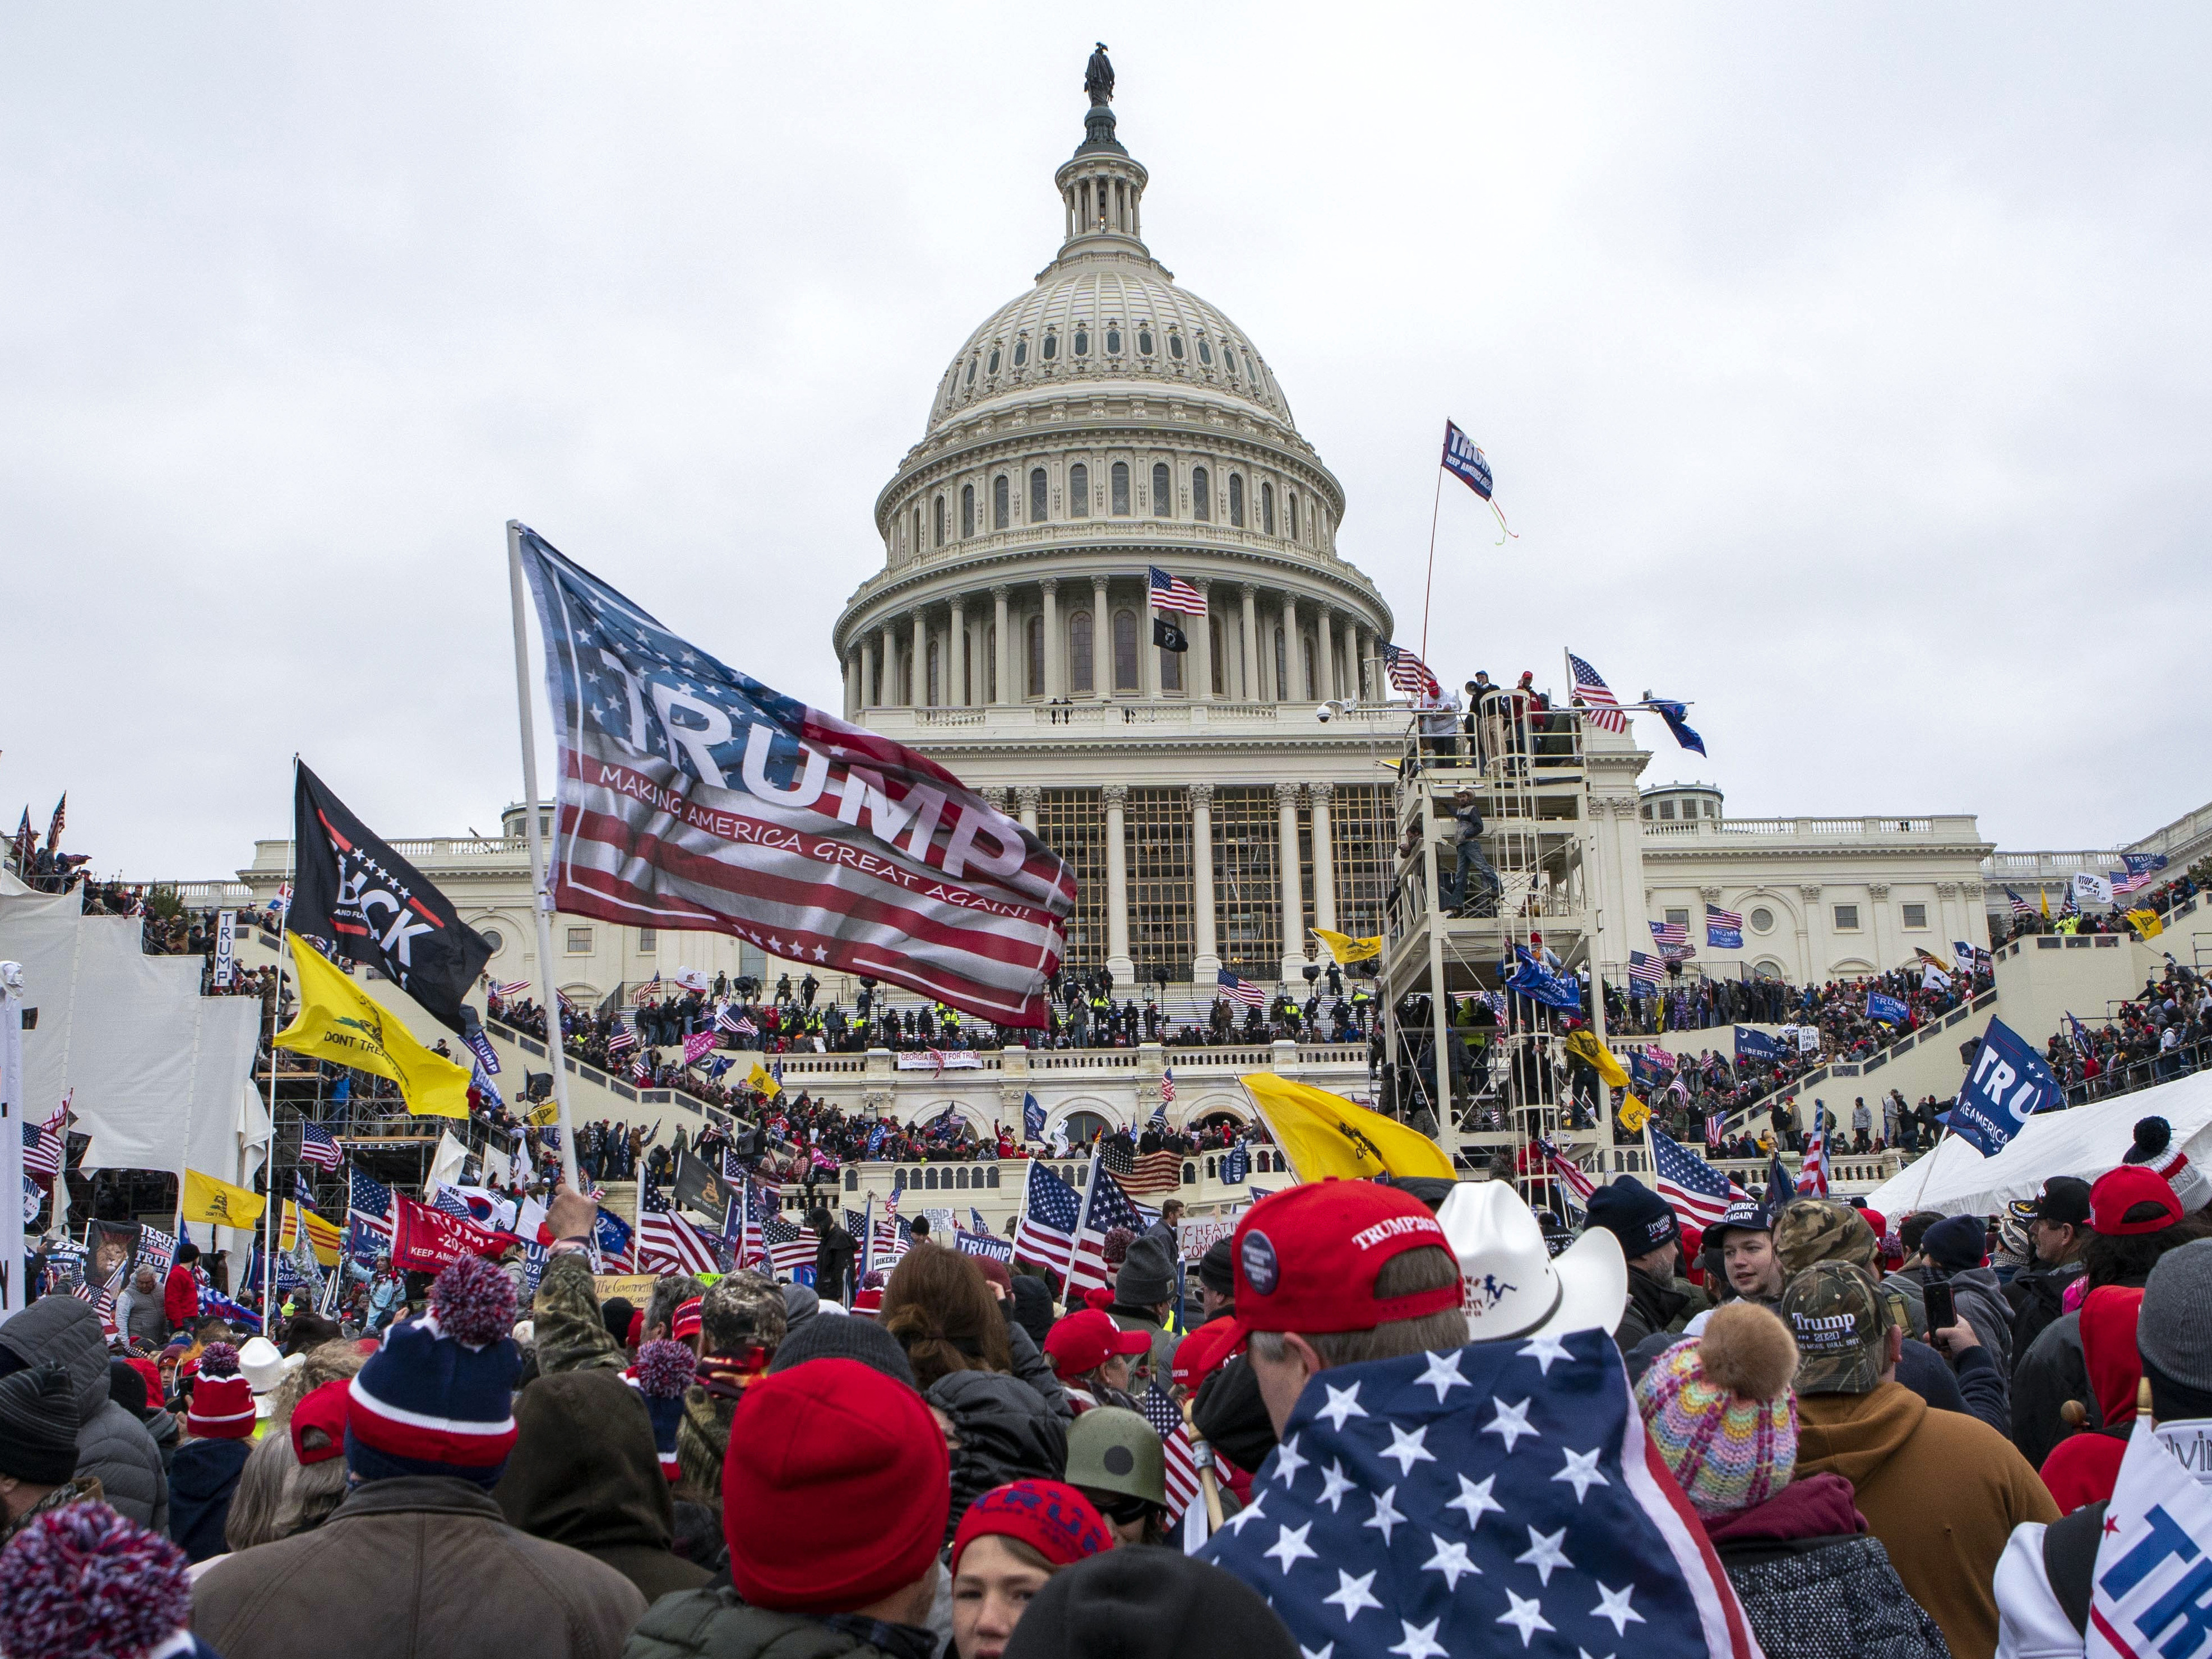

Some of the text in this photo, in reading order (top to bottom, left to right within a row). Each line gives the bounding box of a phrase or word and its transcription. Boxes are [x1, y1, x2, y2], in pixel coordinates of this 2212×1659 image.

[1446, 453, 1460, 467] KEEP
[1460, 462, 1483, 482] AMERICA
[599, 648, 1026, 878] TRUMP
[600, 766, 1030, 919] MAKING AMERICA GREAT AGAIN!
[2078, 875, 2094, 886] STOP
[1711, 928, 1738, 937] TRUMP
[217, 914, 232, 984] TRUMP
[1534, 989, 1561, 1004] AMERICA
[1874, 996, 1906, 1012] TRUMP
[324, 1031, 357, 1048] DONT
[474, 1031, 498, 1072] TRUMP
[901, 1053, 928, 1061] GEORGIA
[929, 1052, 947, 1061] FIGT
[948, 1051, 961, 1060] FOR
[1741, 1046, 1774, 1058] LIBERTY
[1973, 1045, 2042, 1123] TRU
[1969, 1112, 2008, 1145] AMERICA
[925, 1209, 949, 1217] SEND
[1729, 1212, 1753, 1221] AGAIN
[975, 1220, 989, 1233] TR
[1646, 1215, 1670, 1232] Trump
[141, 1224, 178, 1250] JESUS
[411, 1247, 455, 1263] KEEP AME
[960, 1238, 1011, 1261] TRUMP
[876, 1257, 897, 1266] BIKERS
[278, 1273, 300, 1281] 2020
[1792, 1313, 1855, 1333] Trump
[1814, 1331, 1840, 1342] 2020
[1846, 1338, 1859, 1346] SHIT
[2099, 1503, 2212, 1659] TR
